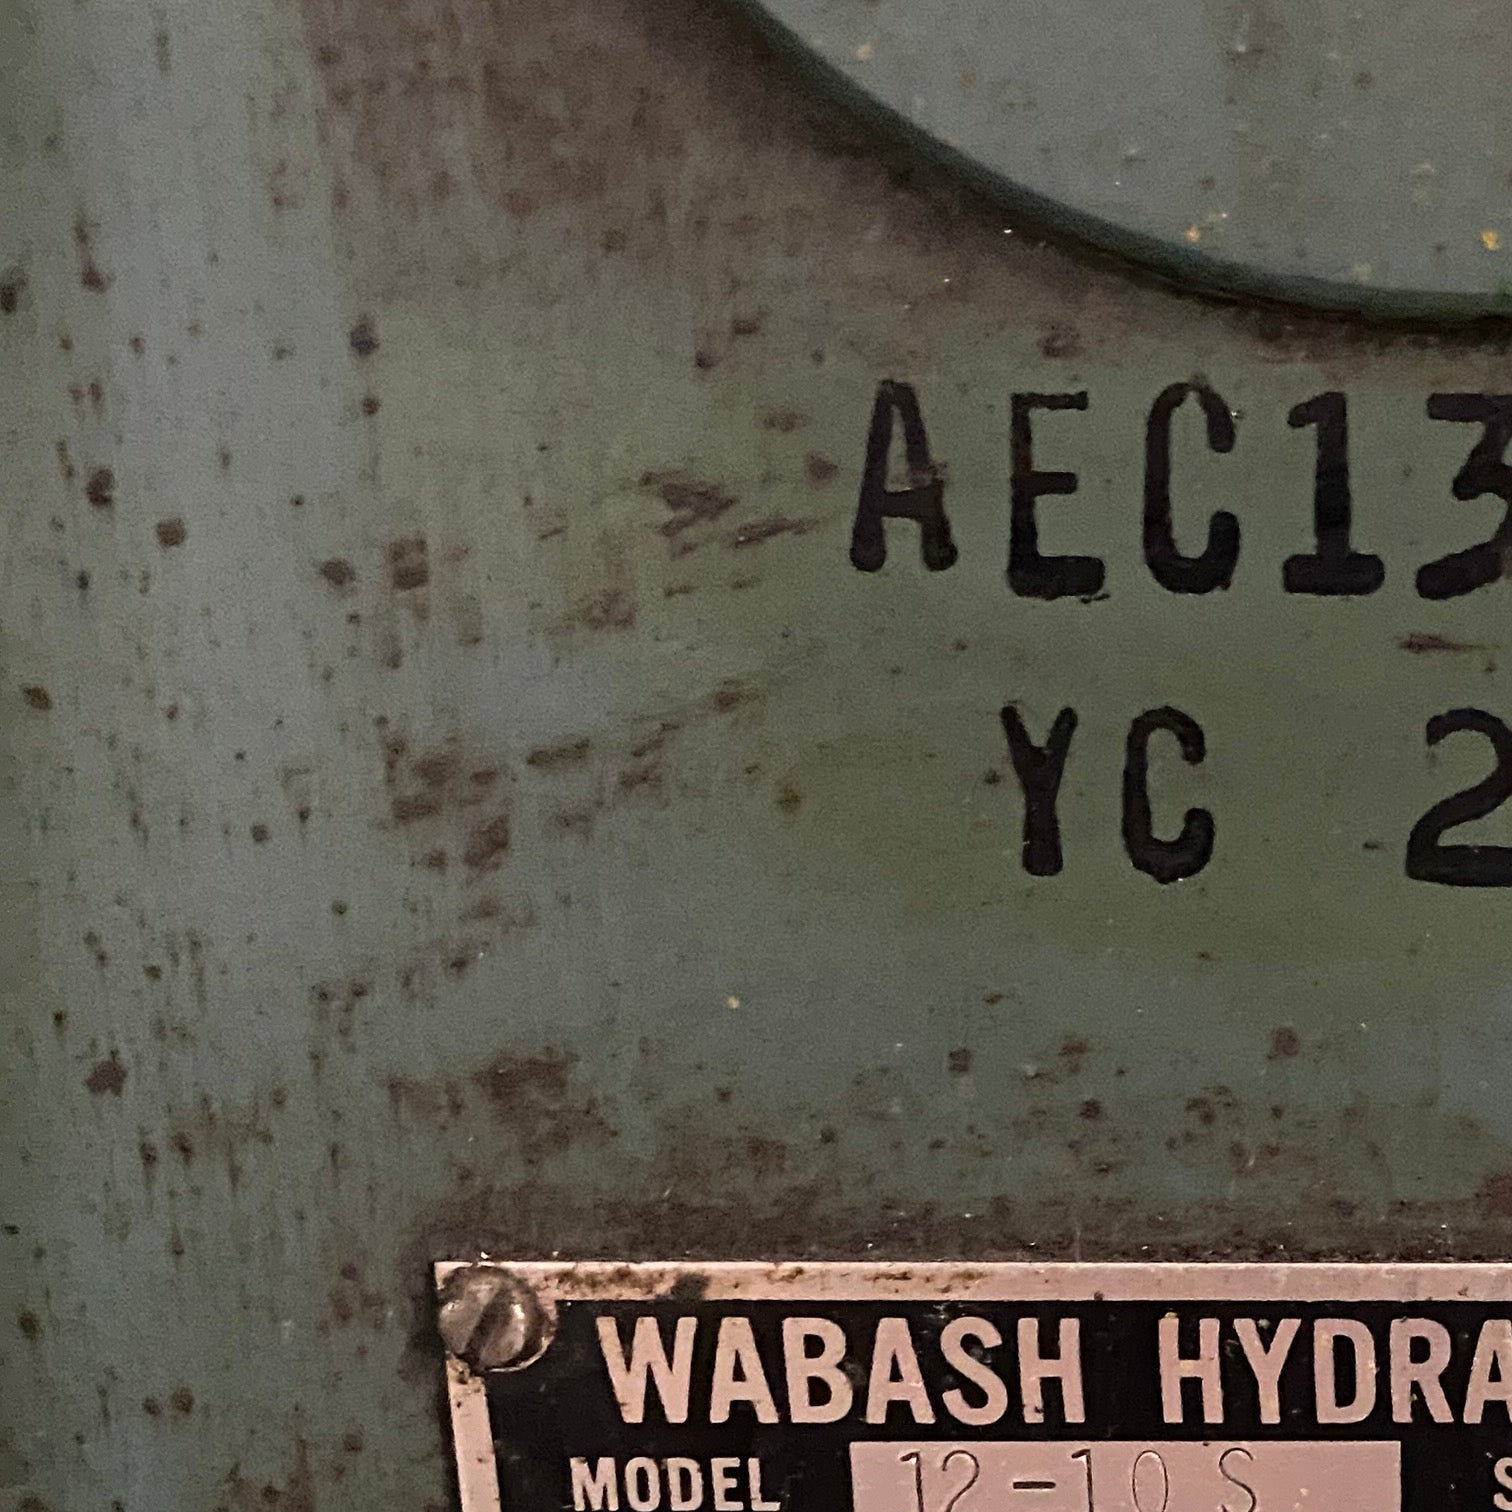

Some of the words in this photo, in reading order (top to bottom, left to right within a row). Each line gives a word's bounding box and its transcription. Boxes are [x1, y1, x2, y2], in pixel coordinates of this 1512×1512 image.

[999, 705, 1216, 885] YC
[596, 1316, 1086, 1426] WABASH
[568, 1456, 782, 1512] MODEL
